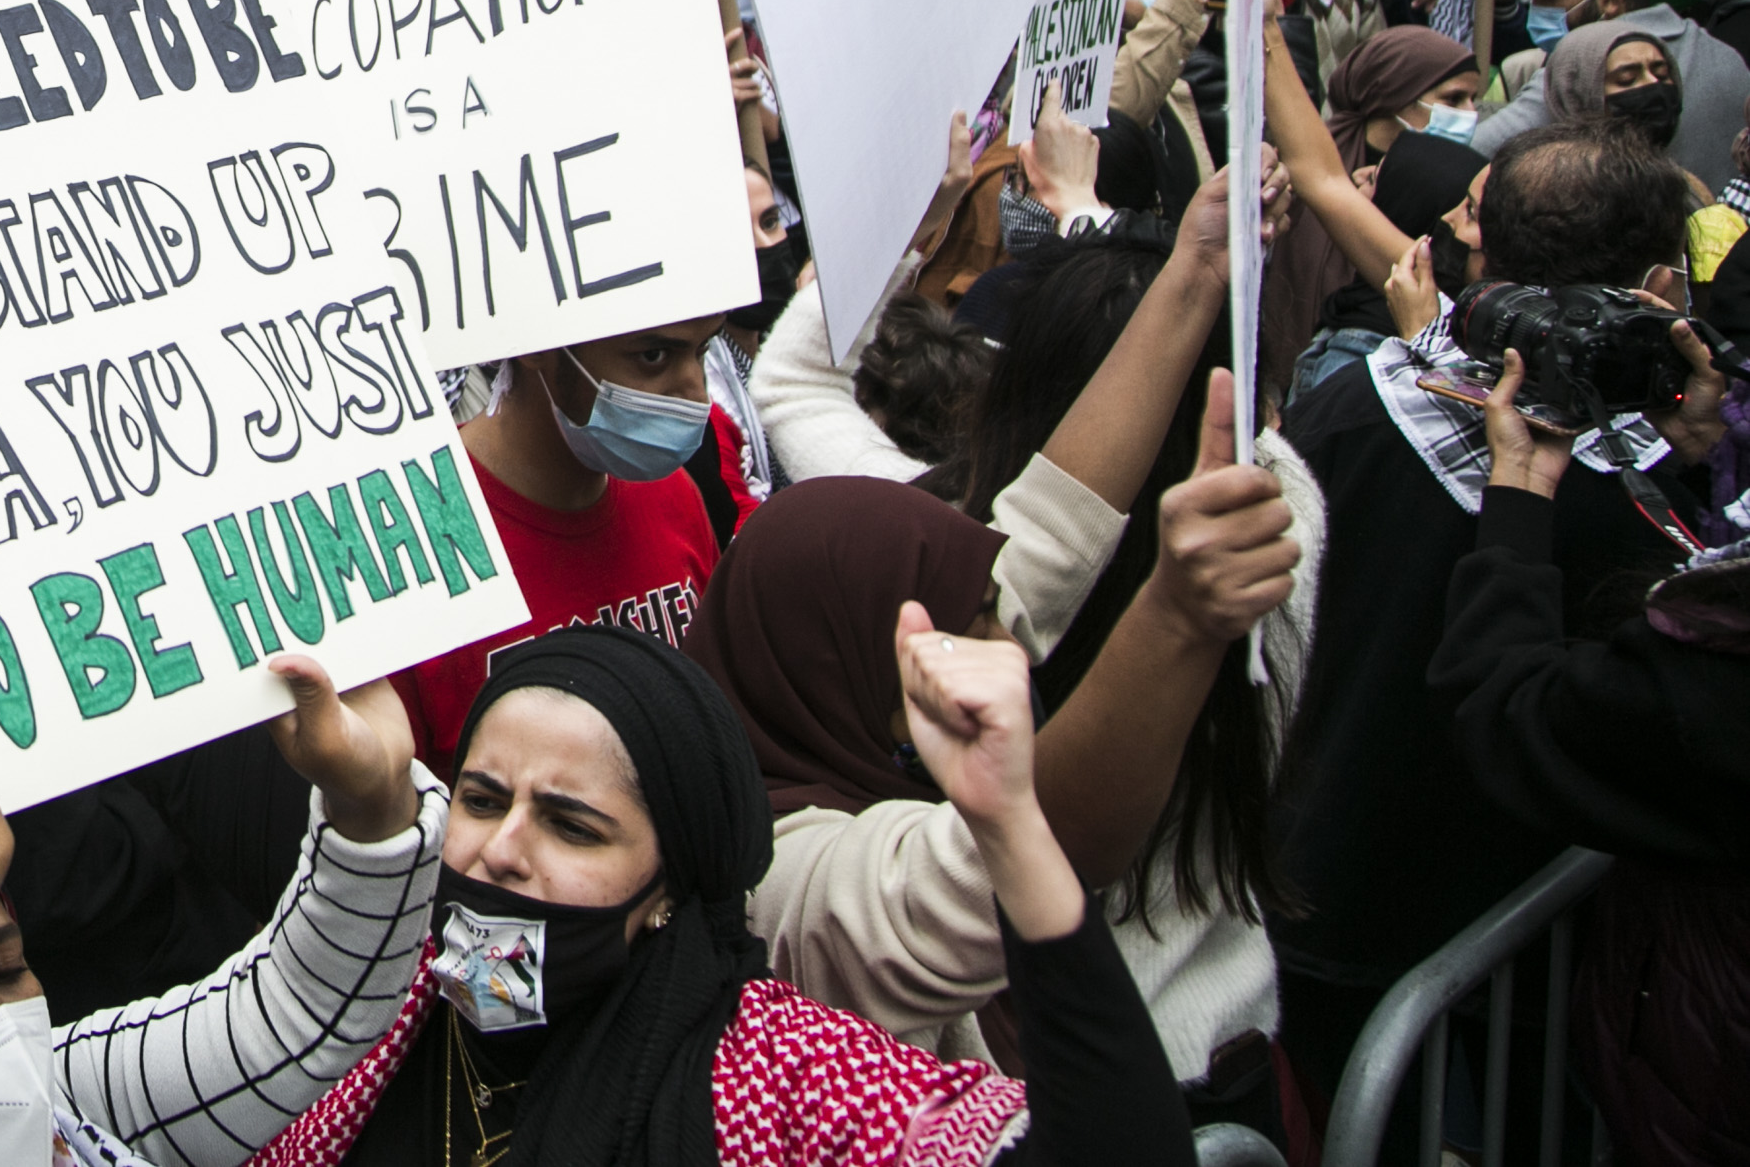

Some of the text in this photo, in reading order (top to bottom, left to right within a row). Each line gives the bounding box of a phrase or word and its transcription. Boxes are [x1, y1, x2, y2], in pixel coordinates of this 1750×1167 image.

[207, 141, 336, 275] UP
[390, 74, 492, 141] IS A
[363, 132, 665, 333] RIME
[25, 342, 218, 510] YOU
[221, 286, 434, 463] JUST
[29, 542, 205, 722] BE
[181, 444, 499, 672] HUMAN
